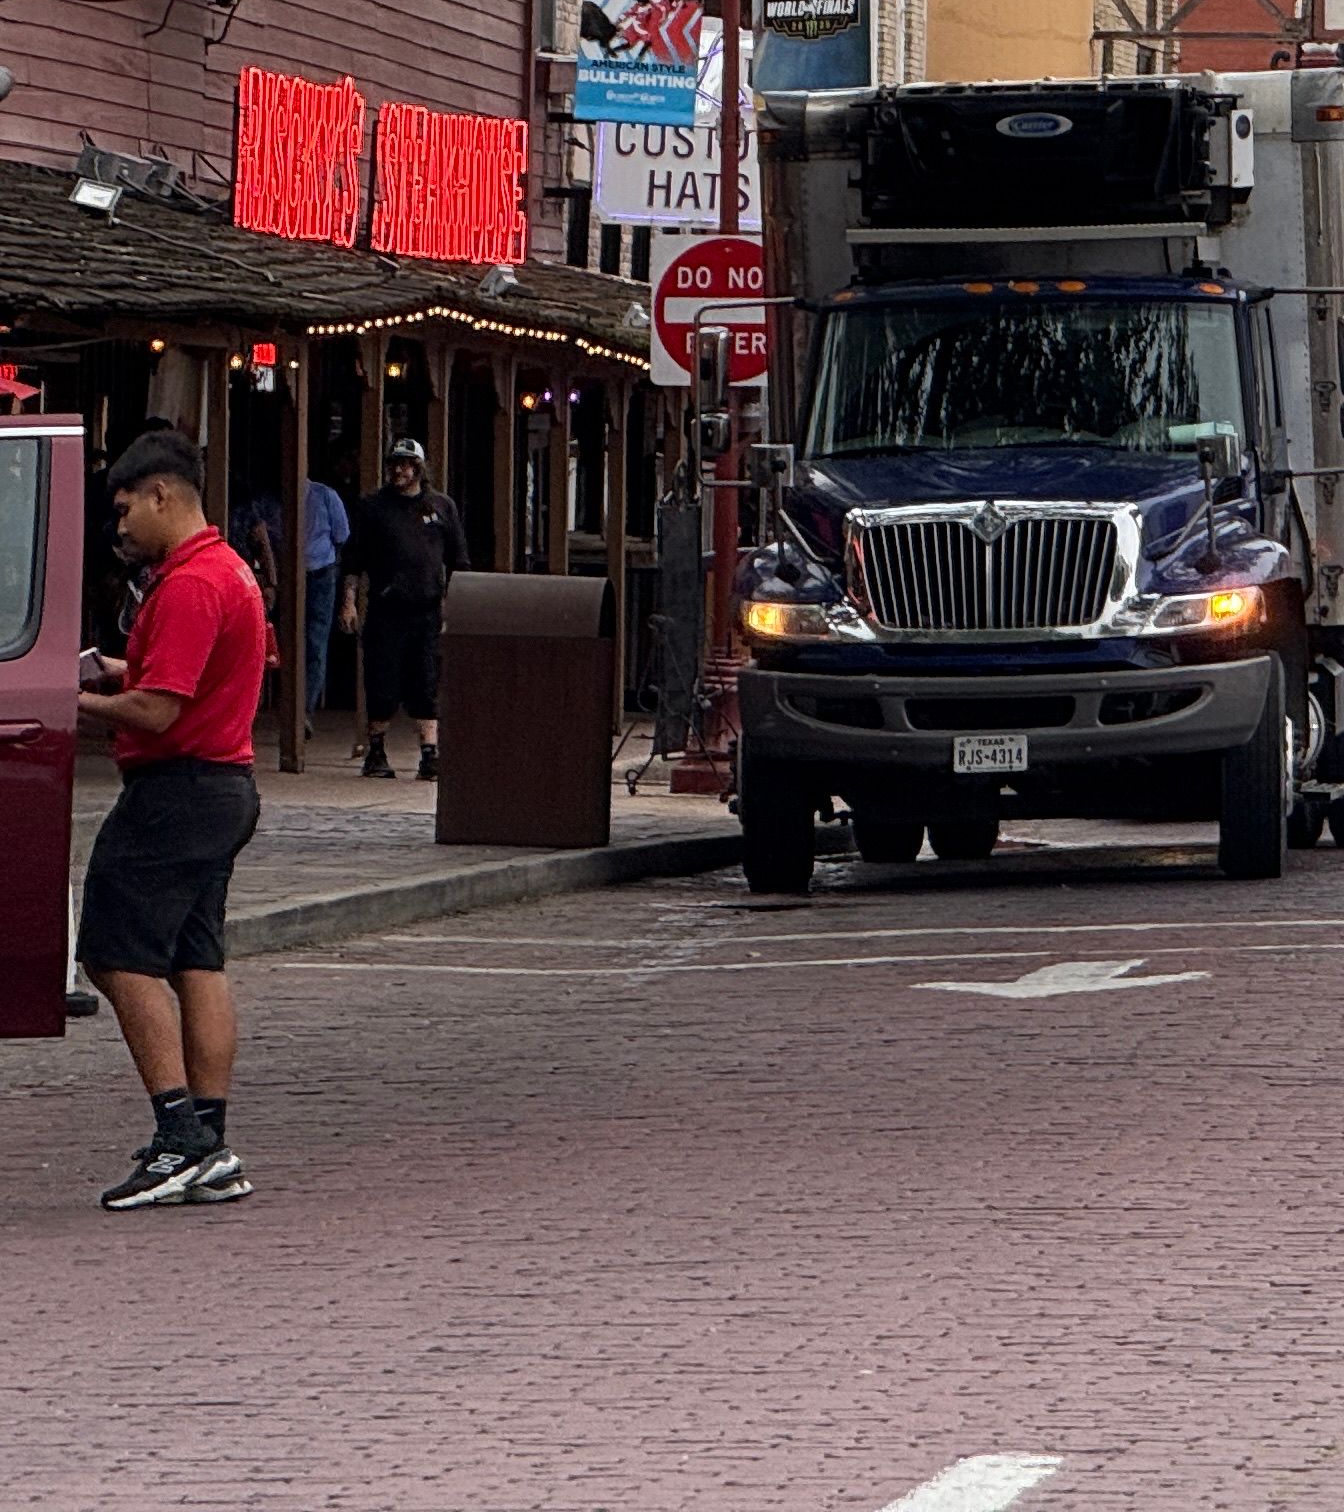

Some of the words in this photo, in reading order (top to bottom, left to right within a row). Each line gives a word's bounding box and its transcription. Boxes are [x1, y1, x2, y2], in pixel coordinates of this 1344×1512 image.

[767, 0, 805, 18] WORLD
[591, 60, 648, 72] AMERICAN
[652, 64, 686, 73] STYLE
[577, 69, 696, 89] BULLFIGHTING
[647, 169, 751, 212] HATS
[677, 266, 712, 289] DO
[728, 266, 764, 289] NO
[978, 738, 1005, 746] TEXAS
[958, 748, 1023, 766] RJS-4314
